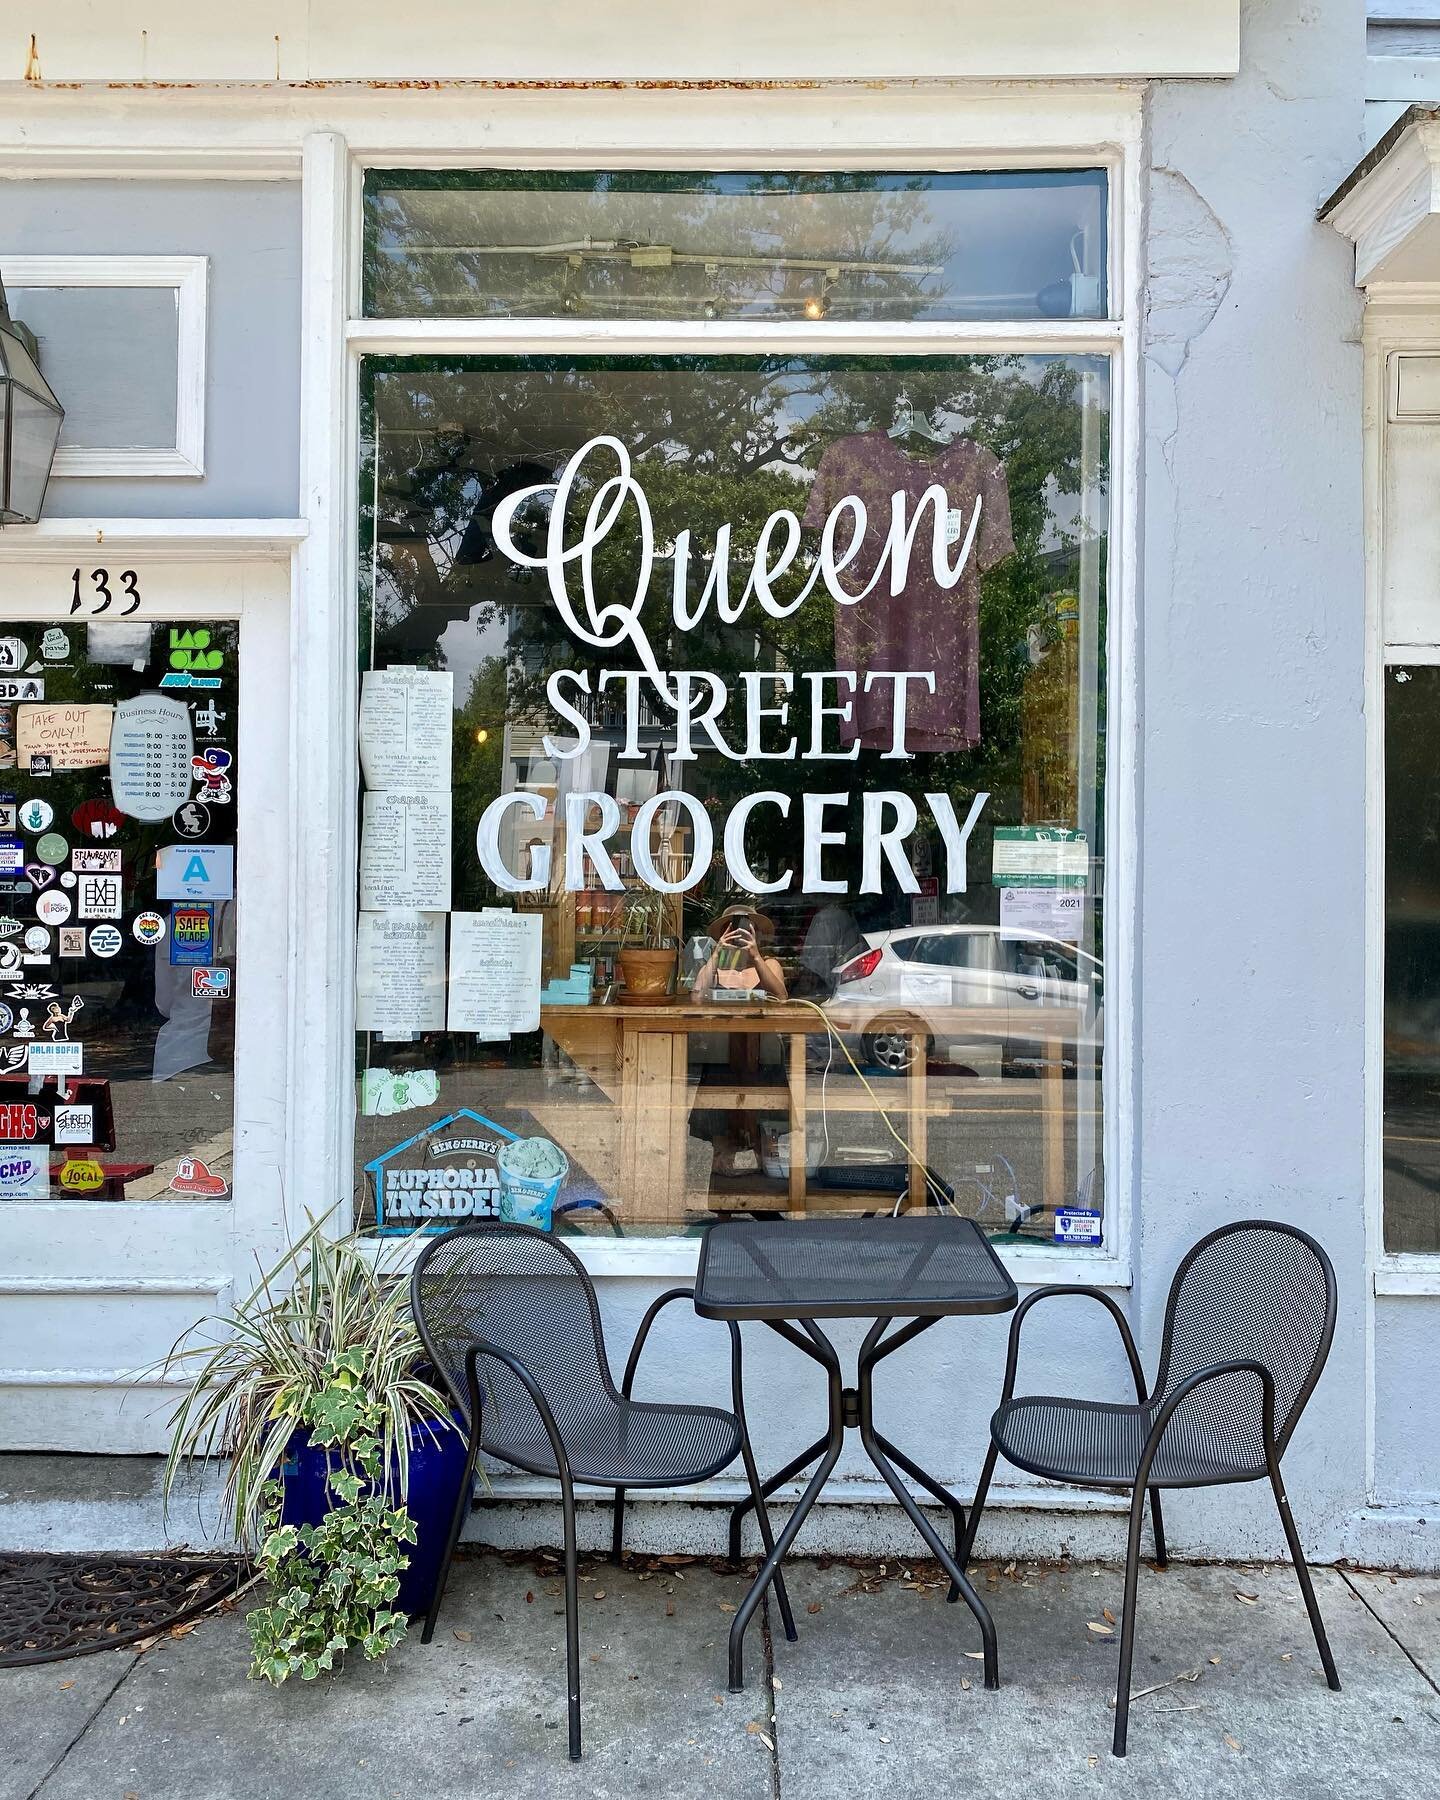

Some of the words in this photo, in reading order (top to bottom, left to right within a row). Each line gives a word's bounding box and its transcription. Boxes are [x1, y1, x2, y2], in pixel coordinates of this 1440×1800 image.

[491, 435, 982, 710] Queen
[70, 567, 141, 615] 133
[169, 628, 211, 649] LAS
[169, 649, 224, 670] OLAS
[21, 709, 59, 729] TAKE
[64, 710, 91, 723] OUT
[120, 708, 157, 720] Business
[158, 707, 185, 720] Hours
[542, 668, 937, 761] STREET
[39, 725, 85, 739] ONLY!!
[476, 790, 991, 895] GROCERY
[182, 855, 210, 882] A
[1059, 899, 1081, 908] 2021
[179, 917, 206, 931] SAFE
[179, 931, 206, 942] PLACE
[55, 1045, 79, 1054] SOFIA
[0, 1160, 32, 1179] CMP
[65, 1168, 99, 1185] LOCAL
[386, 1168, 499, 1189] EUPHORIA
[385, 1189, 500, 1218] INSIDE!
